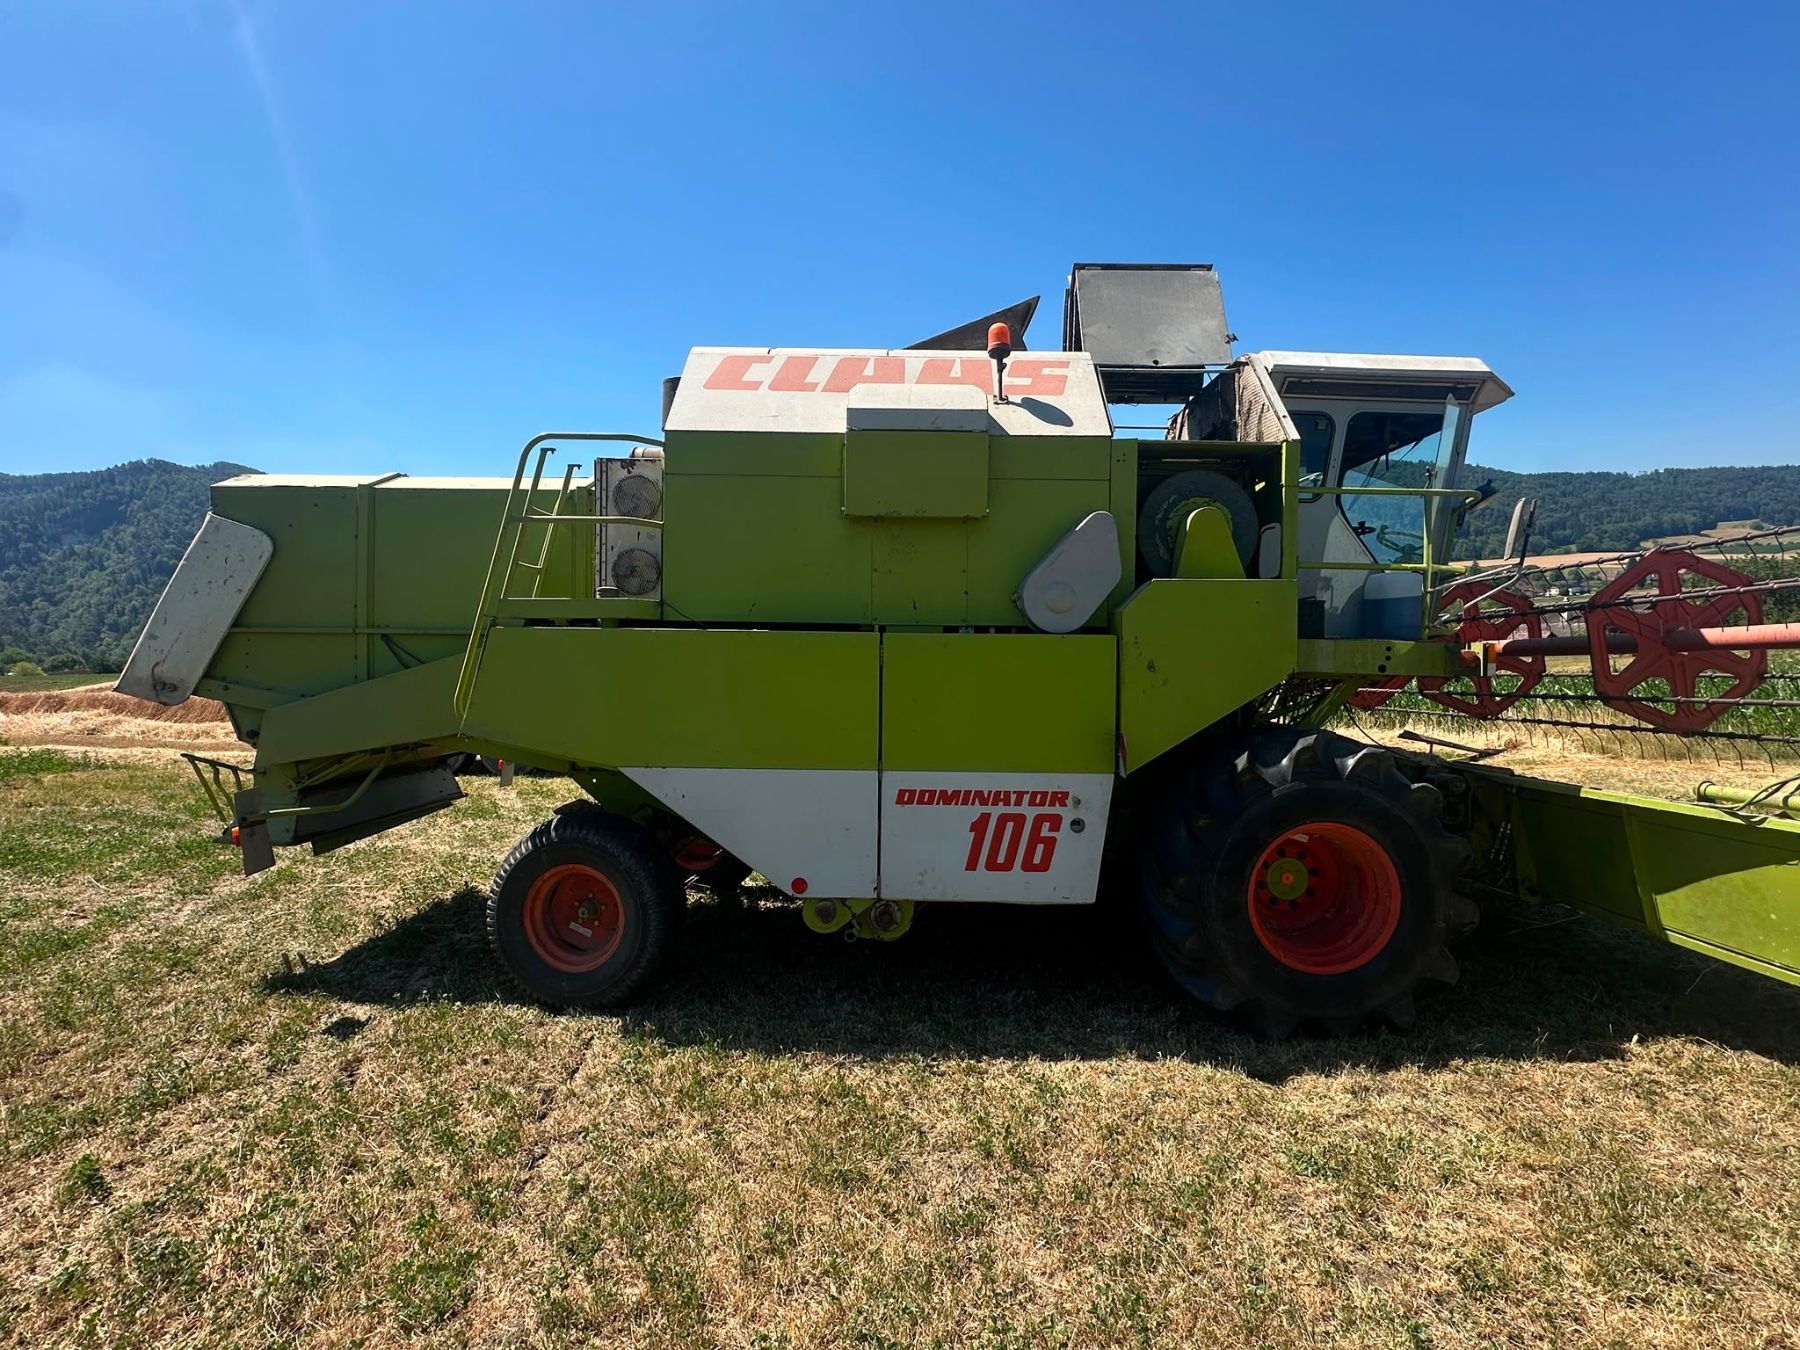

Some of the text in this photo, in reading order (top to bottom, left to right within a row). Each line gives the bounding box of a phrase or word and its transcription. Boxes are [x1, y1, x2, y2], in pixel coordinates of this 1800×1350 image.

[703, 355, 1071, 395] CLAAS
[895, 788, 1070, 807] DOMINATOR
[964, 812, 1063, 873] 106
